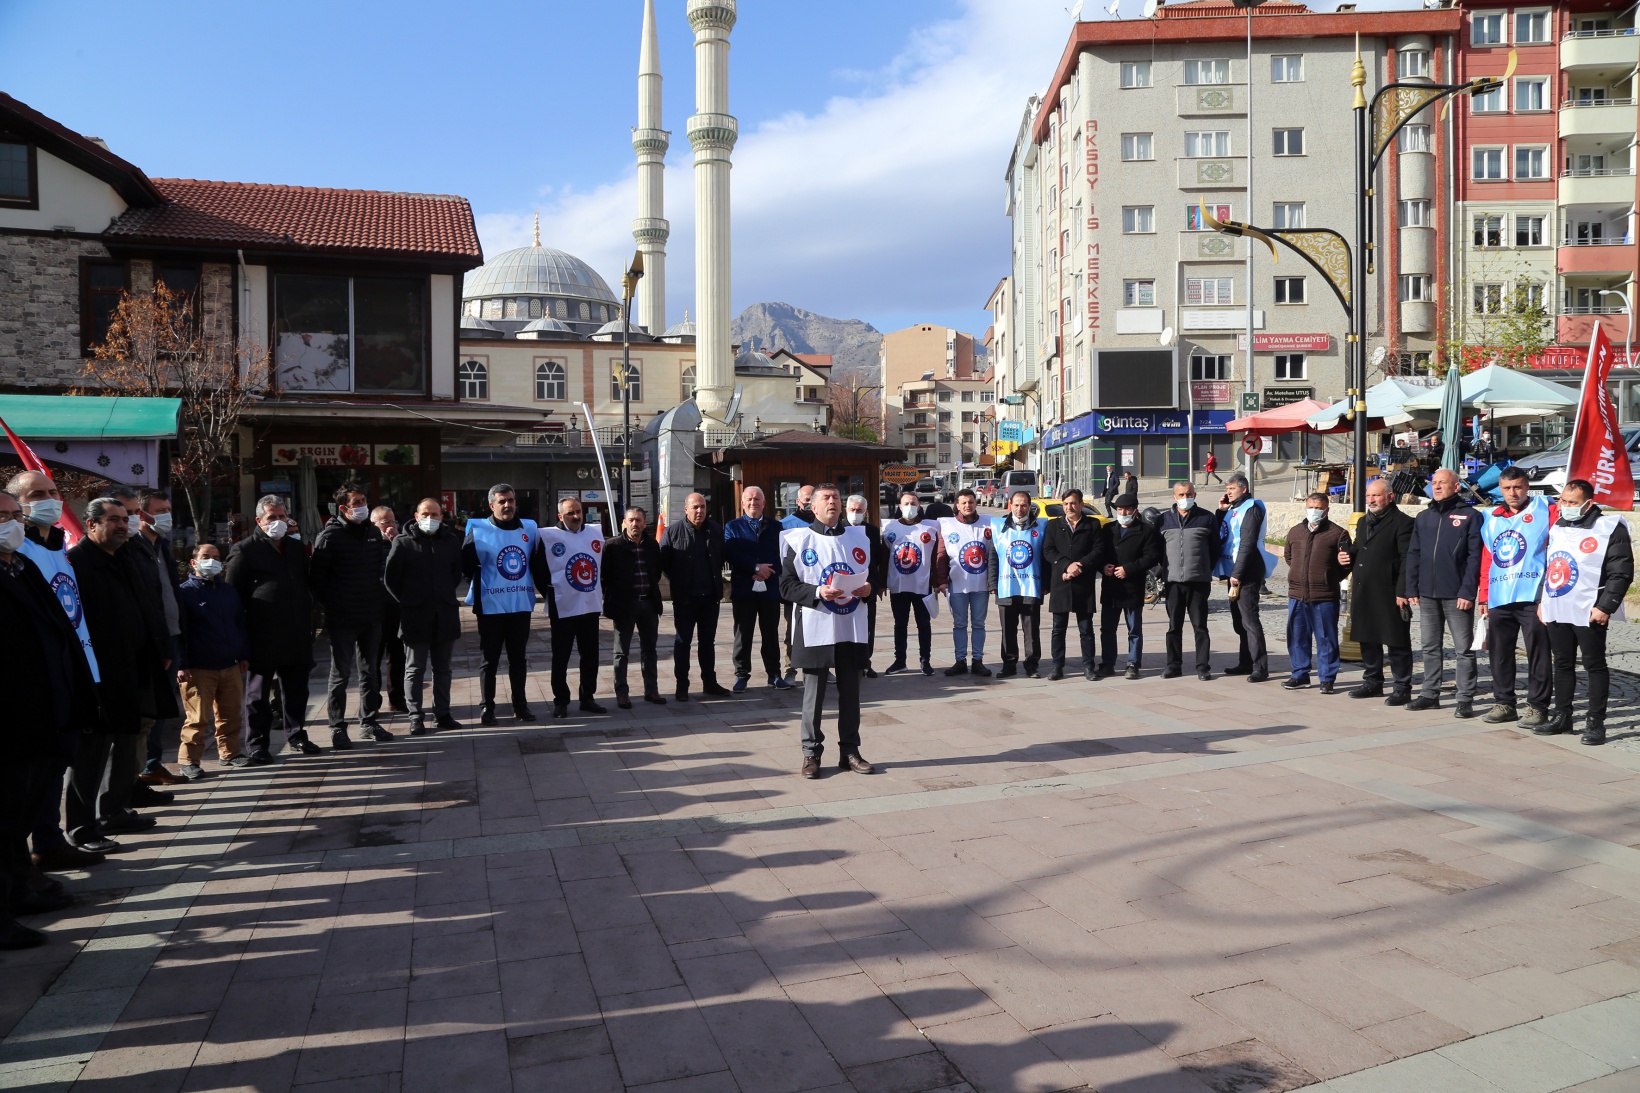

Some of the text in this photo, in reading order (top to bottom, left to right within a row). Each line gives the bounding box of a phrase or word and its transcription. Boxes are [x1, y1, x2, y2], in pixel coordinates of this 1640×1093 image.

[1086, 120, 1098, 190] AKSOY
[1087, 243, 1100, 344] MERKEZİ
[1253, 334, 1327, 344] İLİM YAYMA CEMİYETİ
[1103, 415, 1181, 432] güntaş evim
[295, 457, 339, 465] TARET
[1592, 445, 1616, 495] TÜRK
[1549, 552, 1577, 586] SAĞLIK SEN
[486, 587, 505, 595] TÜRK
